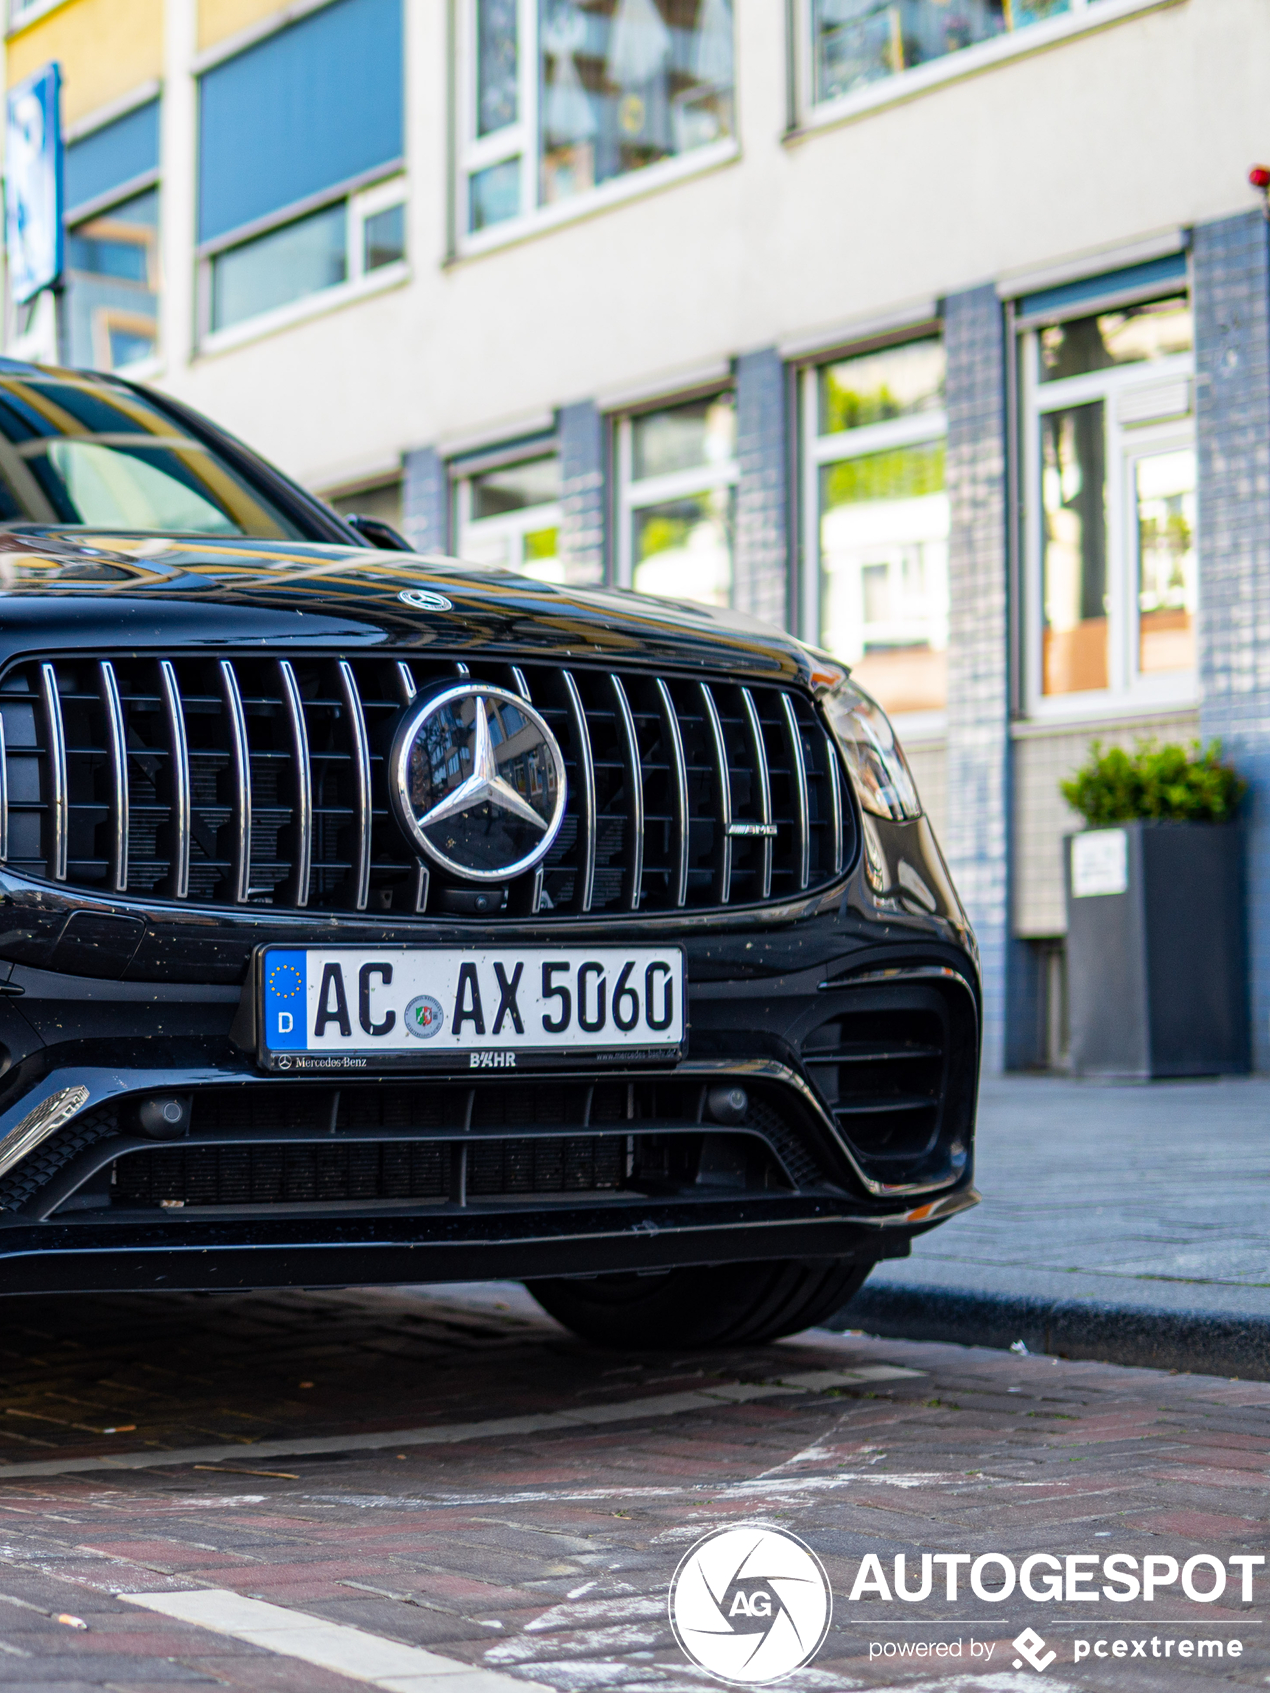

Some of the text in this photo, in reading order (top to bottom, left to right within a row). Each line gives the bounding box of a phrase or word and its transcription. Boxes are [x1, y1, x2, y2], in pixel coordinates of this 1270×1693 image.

[313, 962, 396, 1037] AC
[451, 961, 525, 1036] AX
[541, 960, 674, 1034] 5060
[278, 1012, 294, 1034] D
[295, 1056, 367, 1069] Mercedes-Benz
